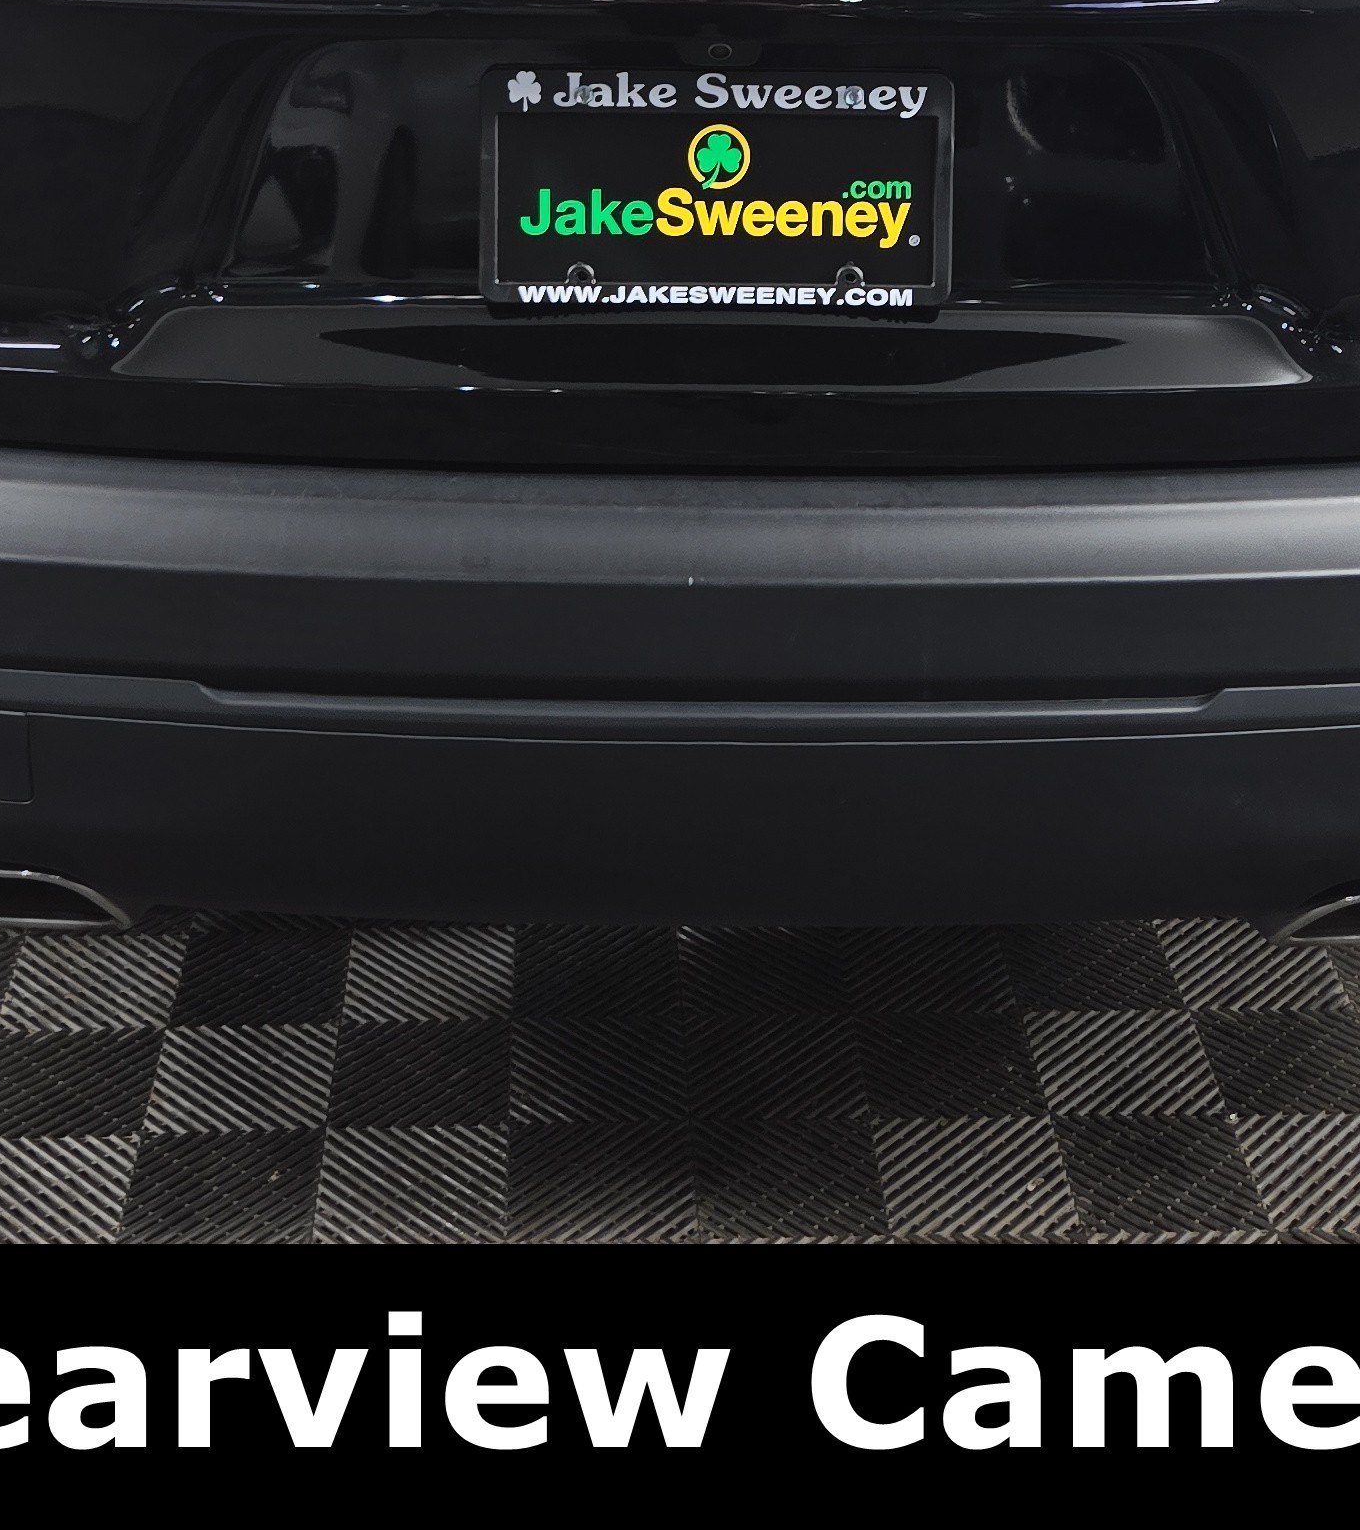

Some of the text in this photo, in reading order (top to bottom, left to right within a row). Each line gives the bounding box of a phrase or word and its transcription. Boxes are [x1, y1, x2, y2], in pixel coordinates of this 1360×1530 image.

[553, 73, 928, 118] Jake Sweeney
[518, 285, 913, 307] WWW.JAKESWEENEY.COM
